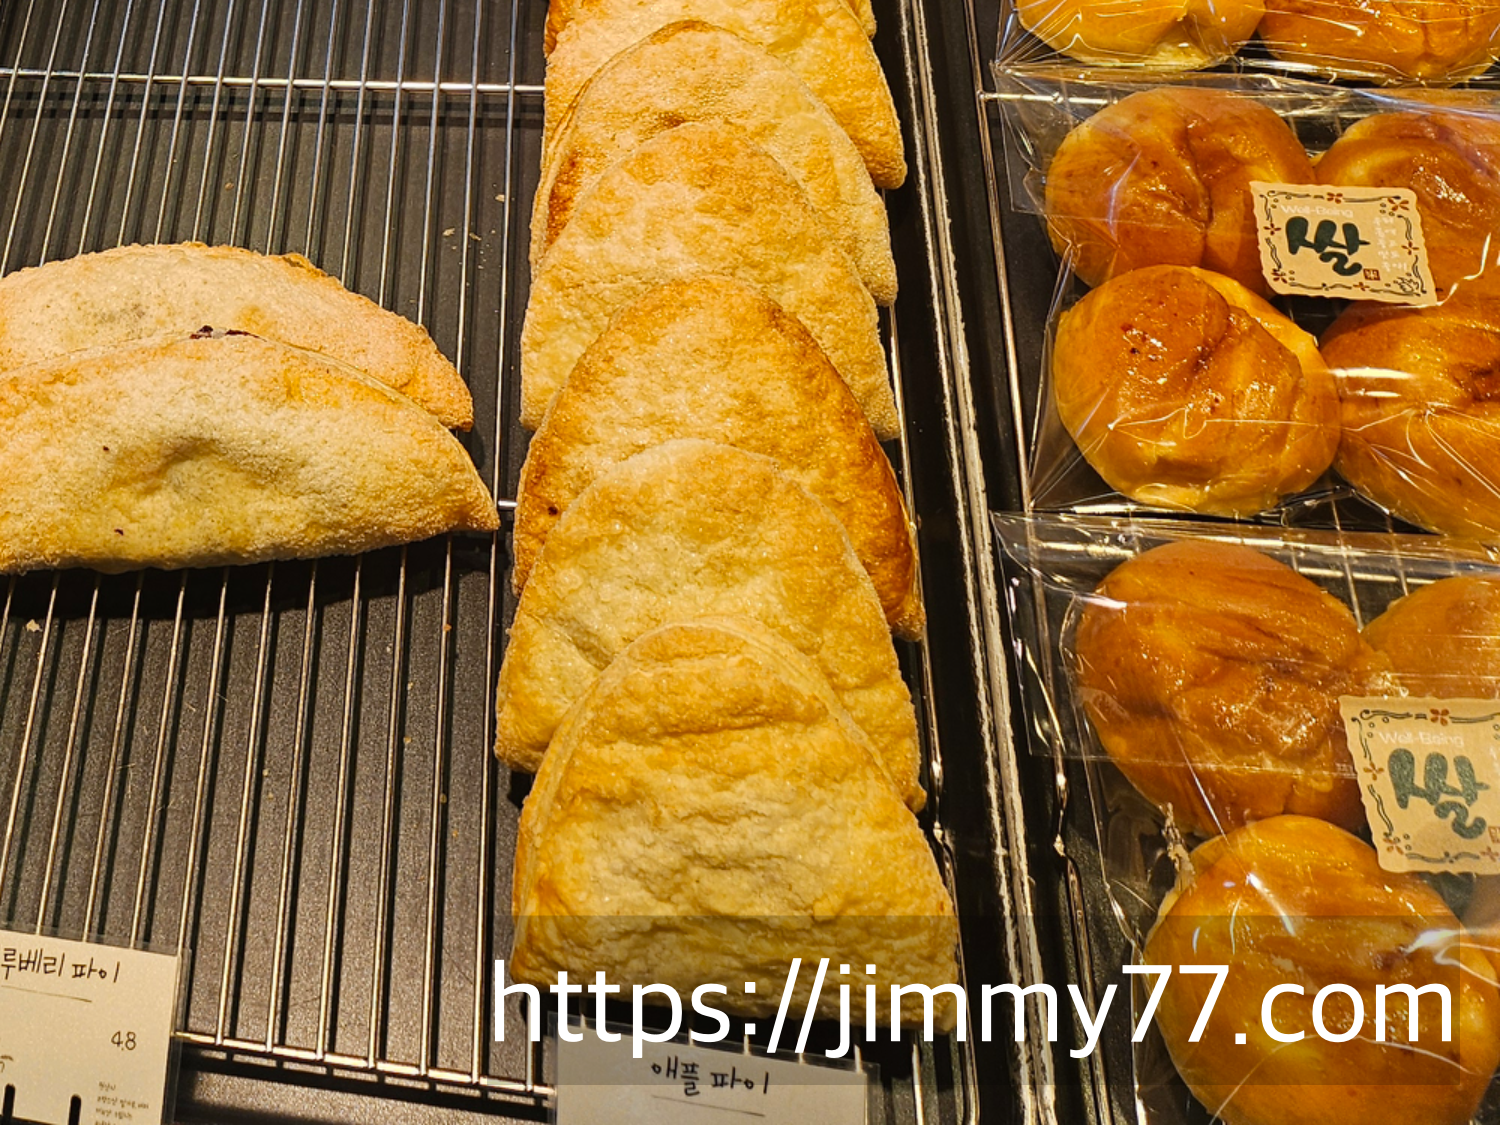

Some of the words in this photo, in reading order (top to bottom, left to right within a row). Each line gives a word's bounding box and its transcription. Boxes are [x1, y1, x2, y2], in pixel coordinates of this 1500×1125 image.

[1285, 215, 1371, 276] 쌀
[1378, 731, 1464, 747] Well-Being
[1388, 748, 1490, 839] 쌀
[71, 957, 121, 983] 파이
[110, 1030, 138, 1052] 4.8
[650, 1055, 701, 1097] 애플
[709, 1066, 770, 1095] 파이
